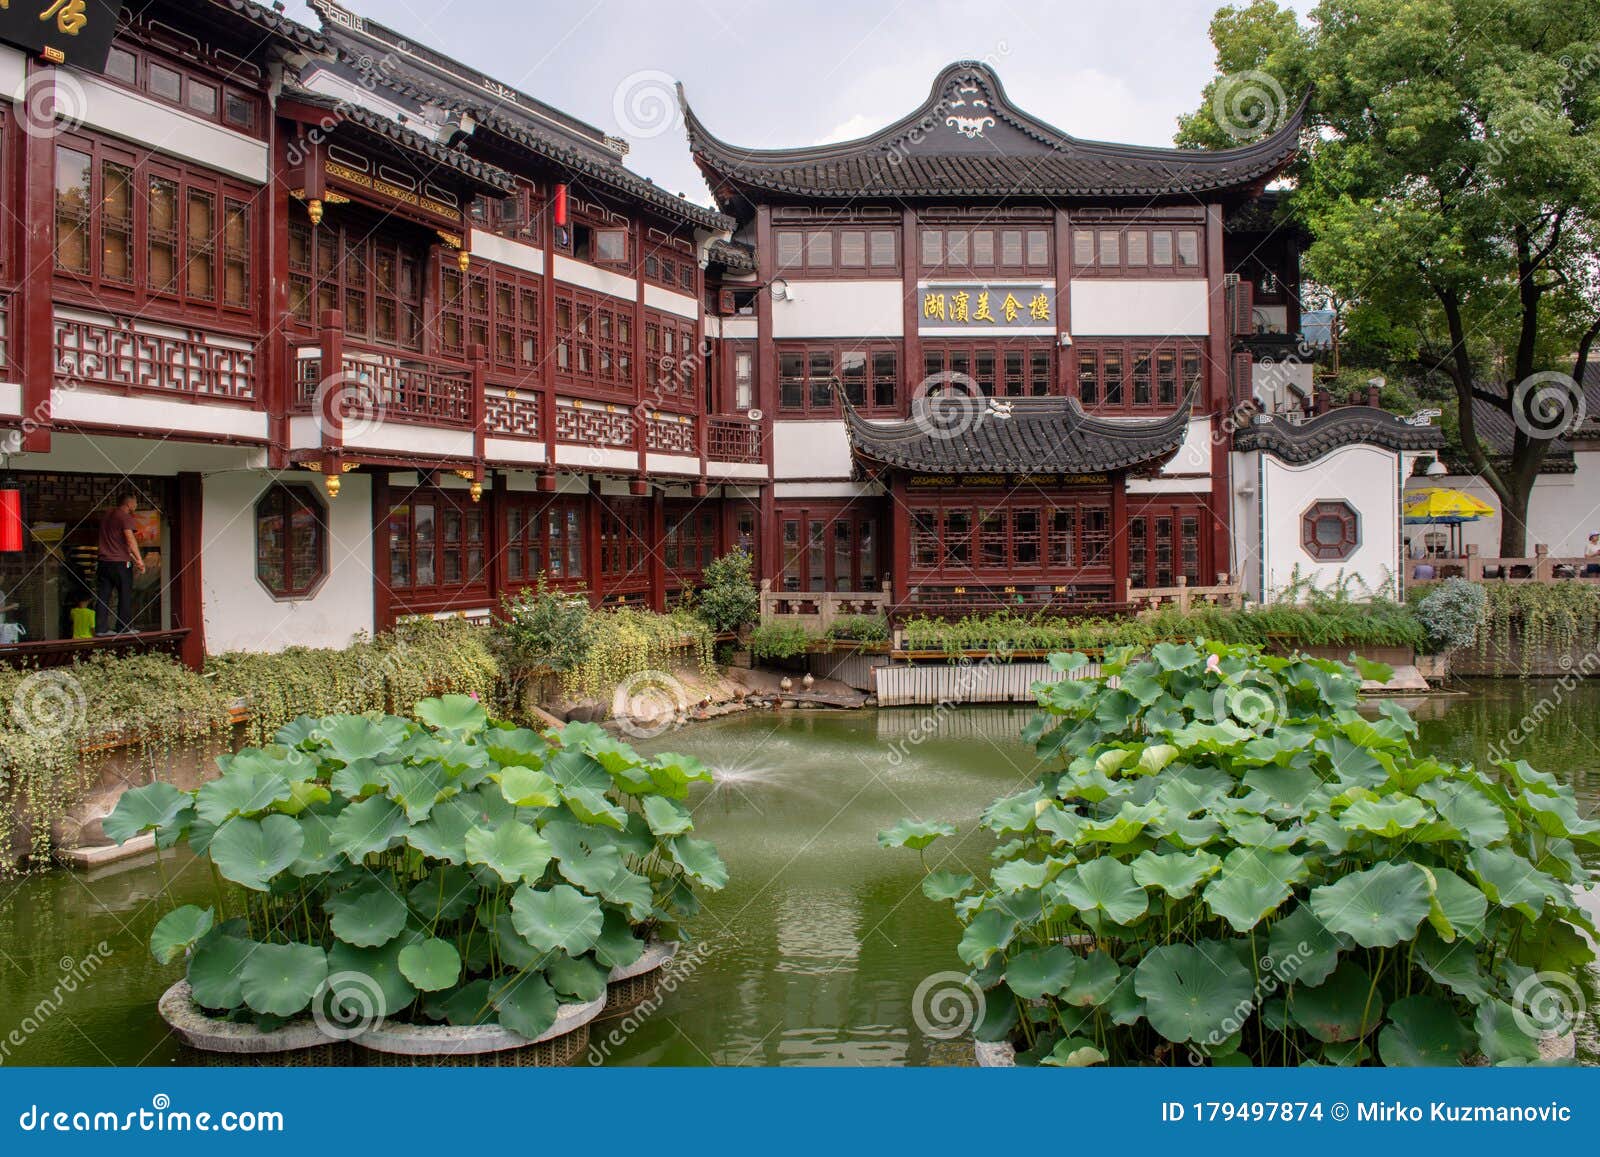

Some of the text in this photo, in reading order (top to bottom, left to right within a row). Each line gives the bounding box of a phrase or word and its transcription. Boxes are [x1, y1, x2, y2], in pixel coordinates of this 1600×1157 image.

[924, 291, 1051, 323] 湖濱美食樓
